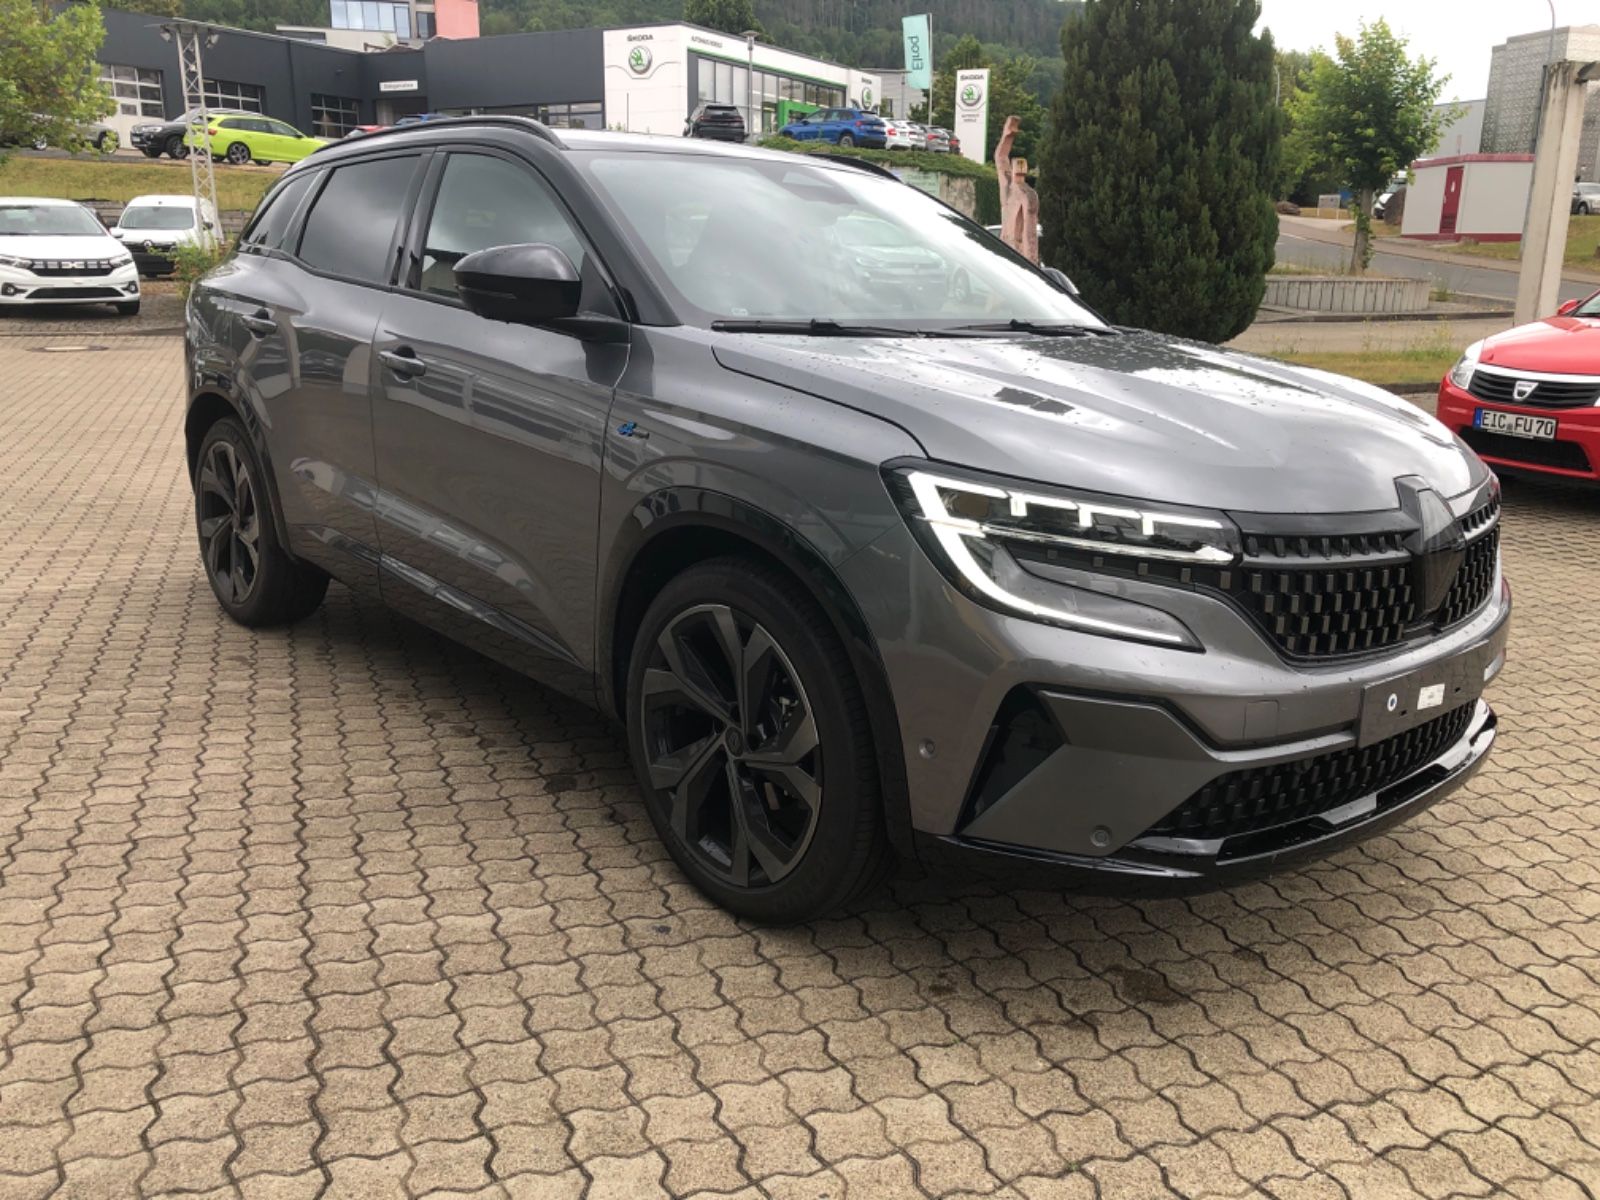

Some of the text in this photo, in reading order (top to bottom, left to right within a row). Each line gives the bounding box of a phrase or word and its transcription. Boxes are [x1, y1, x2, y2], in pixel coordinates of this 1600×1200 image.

[1482, 412, 1506, 429] EIC
[1514, 417, 1533, 432] FU
[1536, 420, 1554, 436] 70
